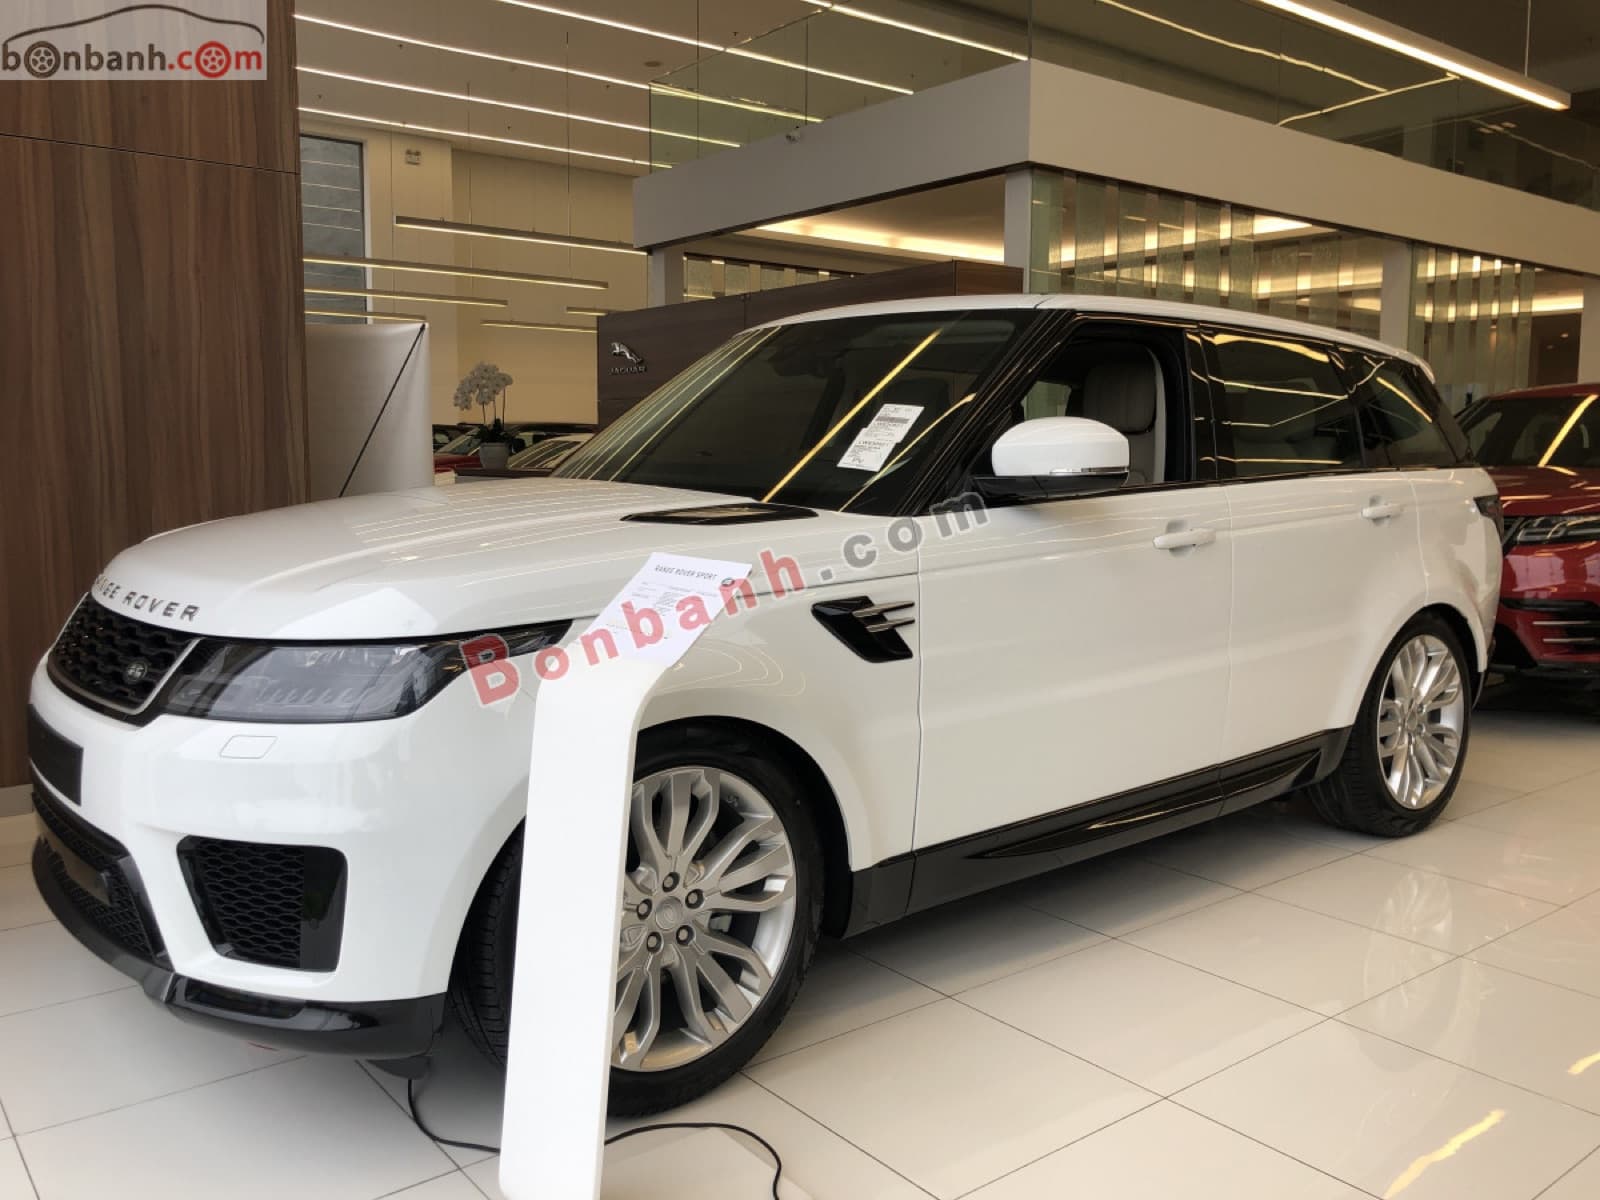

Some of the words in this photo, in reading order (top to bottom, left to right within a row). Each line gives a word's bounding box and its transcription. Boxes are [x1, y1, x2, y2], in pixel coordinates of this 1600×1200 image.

[675, 568, 696, 577] ROVER
[696, 571, 718, 581] SPORT
[122, 591, 200, 622] ROVER
